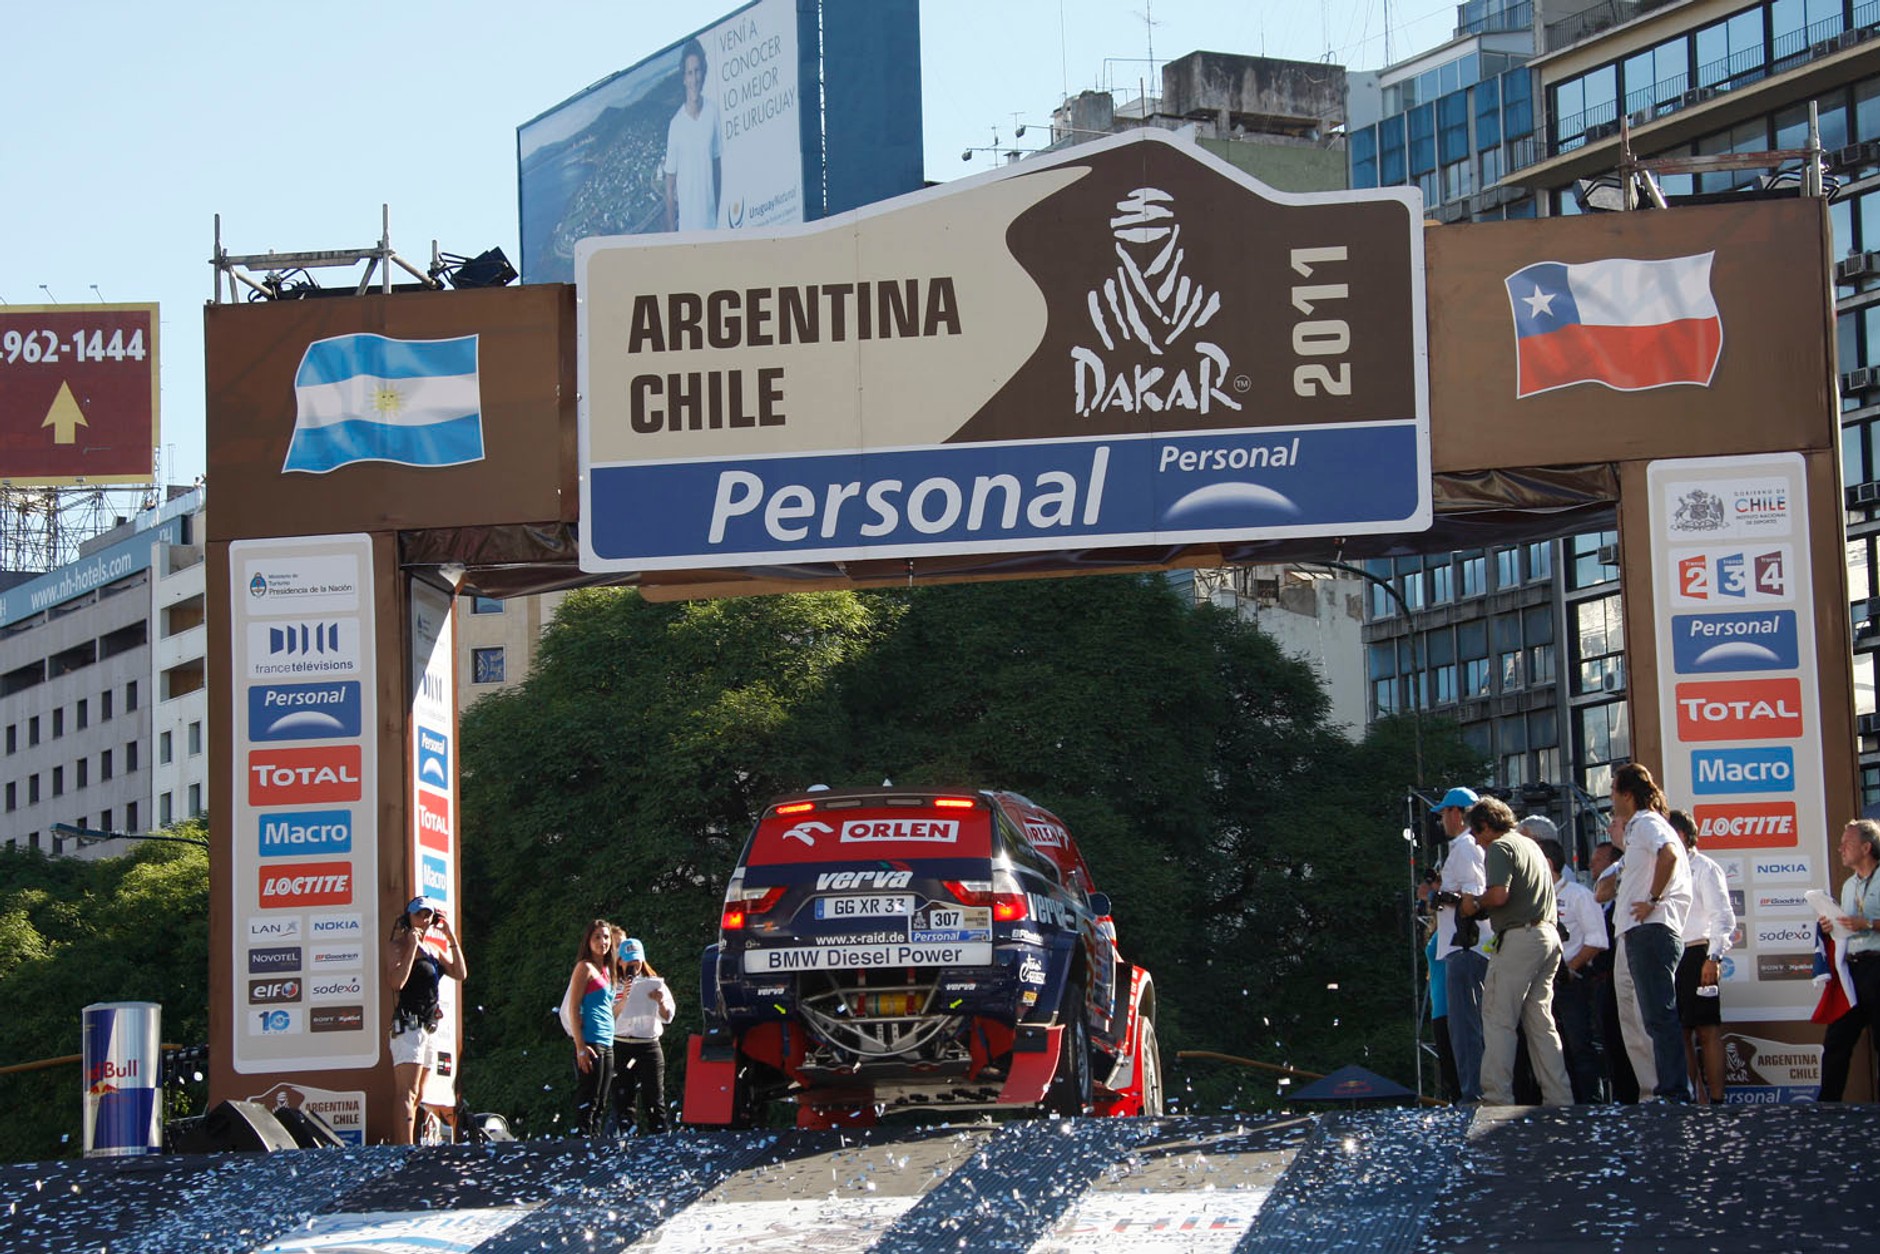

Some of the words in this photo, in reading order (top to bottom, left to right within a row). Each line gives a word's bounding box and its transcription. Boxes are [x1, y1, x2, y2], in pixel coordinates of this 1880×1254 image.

[749, 20, 758, 40] A
[722, 35, 781, 81] CONOCER
[724, 88, 738, 111] LO
[741, 66, 779, 103] MEJOR
[725, 116, 740, 140] DE
[743, 86, 796, 131] URUGUAY
[628, 276, 962, 353] ARGENTINA
[1291, 246, 1352, 397] 2011
[0, 329, 146, 364] 962-1444
[1070, 342, 1242, 418] DAKAR
[630, 367, 786, 434] CHILE
[1159, 438, 1300, 472] Personal
[708, 446, 1110, 544] Personal
[1735, 496, 1786, 513] CHILE
[31, 552, 132, 610] www.nh-hotels.com
[1685, 567, 1707, 593] 2
[1723, 565, 1745, 591] 3
[1760, 562, 1784, 589] 4
[269, 586, 308, 595] Presidencia
[309, 585, 319, 593] de
[328, 584, 352, 592] Nación
[1690, 615, 1780, 637] Personal
[264, 686, 346, 707] Personal
[1679, 698, 1799, 722] TOTAL
[252, 764, 360, 787] TOTAL
[1698, 759, 1790, 782] Macro
[265, 822, 348, 845] Macro
[848, 823, 951, 839] ORLEN
[1700, 815, 1794, 837] LOCTITE
[1757, 863, 1807, 873] NOKIA
[262, 875, 348, 896] LOCTITE
[816, 871, 914, 890] verva
[834, 900, 855, 914] GG
[859, 898, 880, 913] XR
[251, 924, 281, 934] LAN
[314, 921, 359, 931] NOKIA
[934, 912, 959, 926] 307
[816, 931, 905, 945] www.x-raid.de
[914, 931, 960, 941] Personal
[1759, 928, 1811, 941] sodexo
[252, 952, 299, 963] NOVOTEL
[769, 950, 820, 968] BMW
[827, 948, 890, 966] Diesel
[898, 946, 962, 964] Power
[253, 984, 282, 998] elf
[313, 981, 360, 995] sodexo
[103, 1059, 137, 1078] Bull
[1757, 1054, 1818, 1066] ARGENTINA
[1789, 1067, 1819, 1079] CHILE
[305, 1100, 360, 1113] ARGENTINA
[333, 1114, 360, 1125] CHILE
